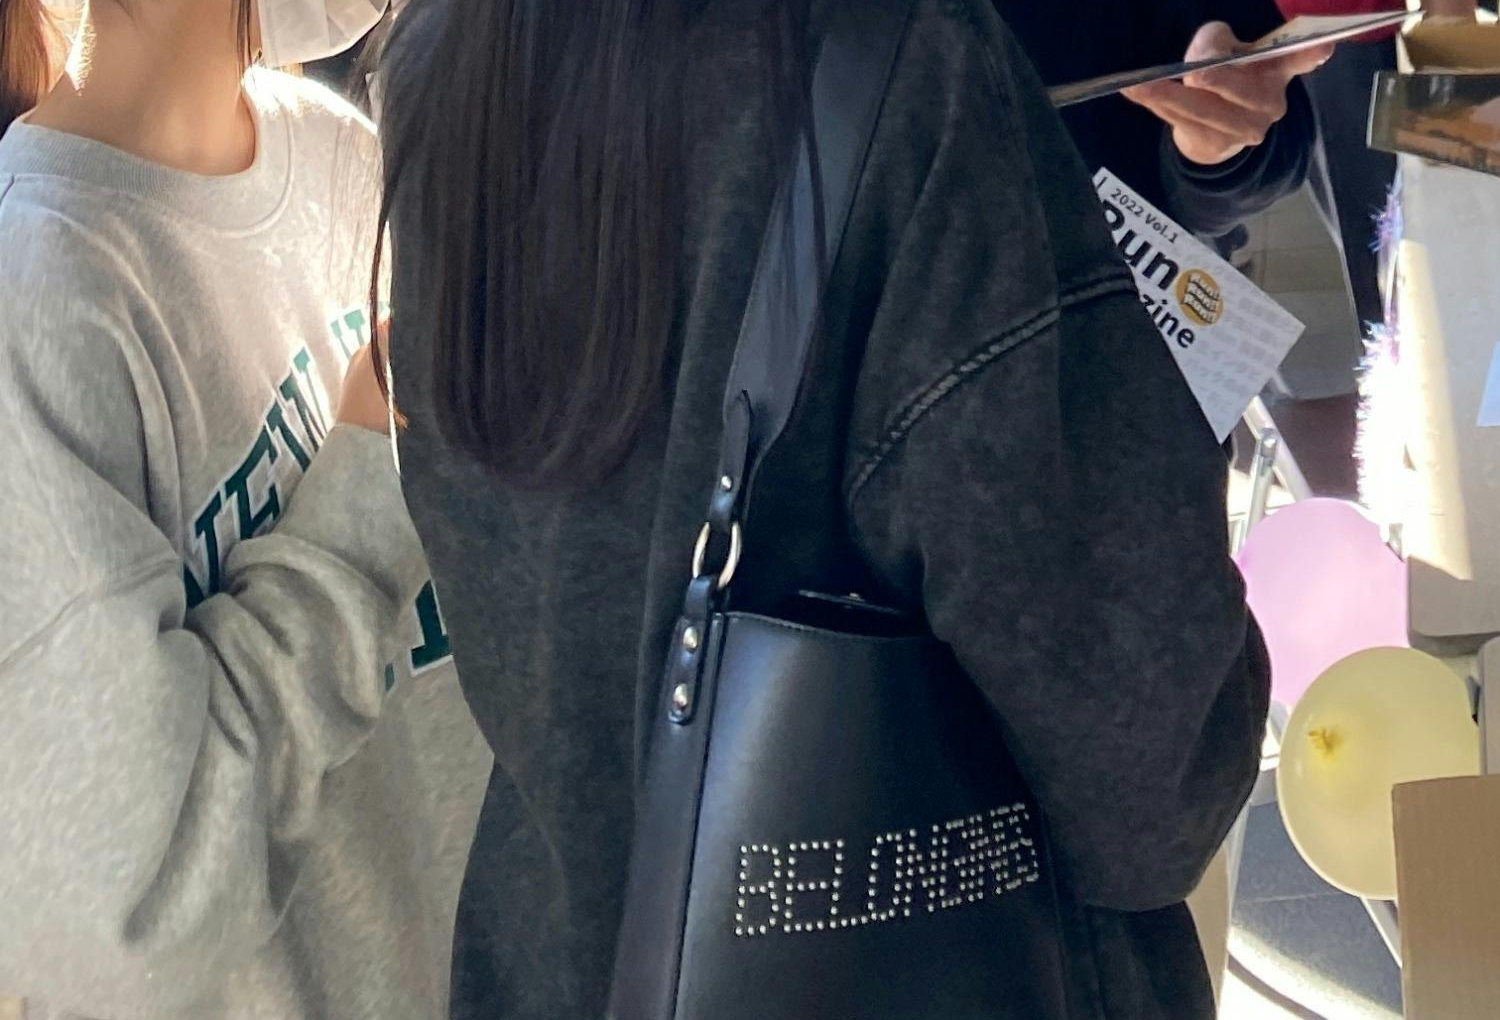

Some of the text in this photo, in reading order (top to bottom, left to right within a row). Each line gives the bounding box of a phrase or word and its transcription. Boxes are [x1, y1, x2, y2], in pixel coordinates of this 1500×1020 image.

[1110, 188, 1179, 244] 2022 Vol.1
[1140, 293, 1196, 349] zine
